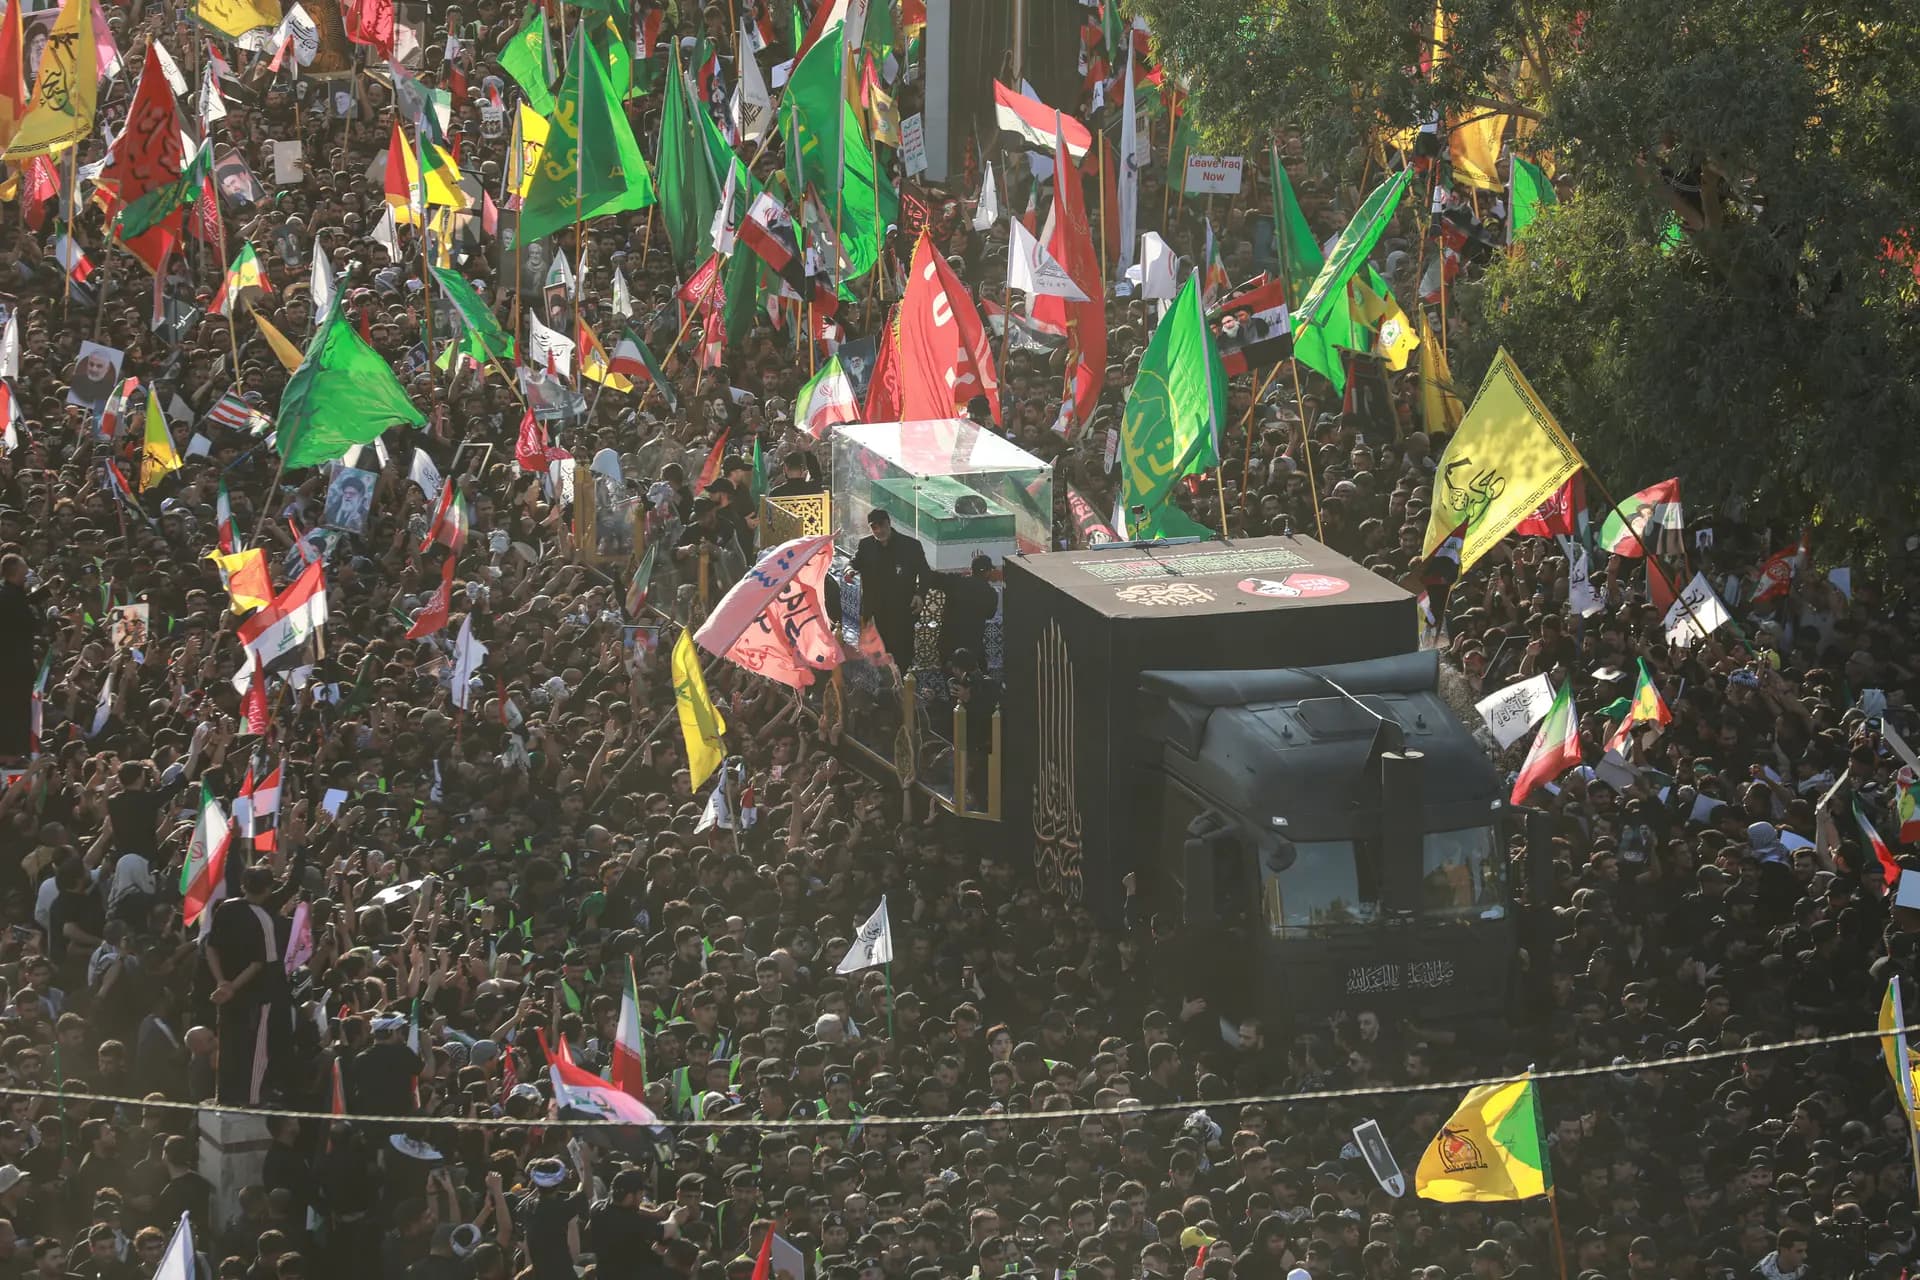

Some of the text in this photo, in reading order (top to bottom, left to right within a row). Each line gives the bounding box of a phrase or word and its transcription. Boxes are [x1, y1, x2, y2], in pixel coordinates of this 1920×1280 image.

[1189, 158, 1241, 171] Leave Iraq
[1202, 171, 1226, 181] Now
